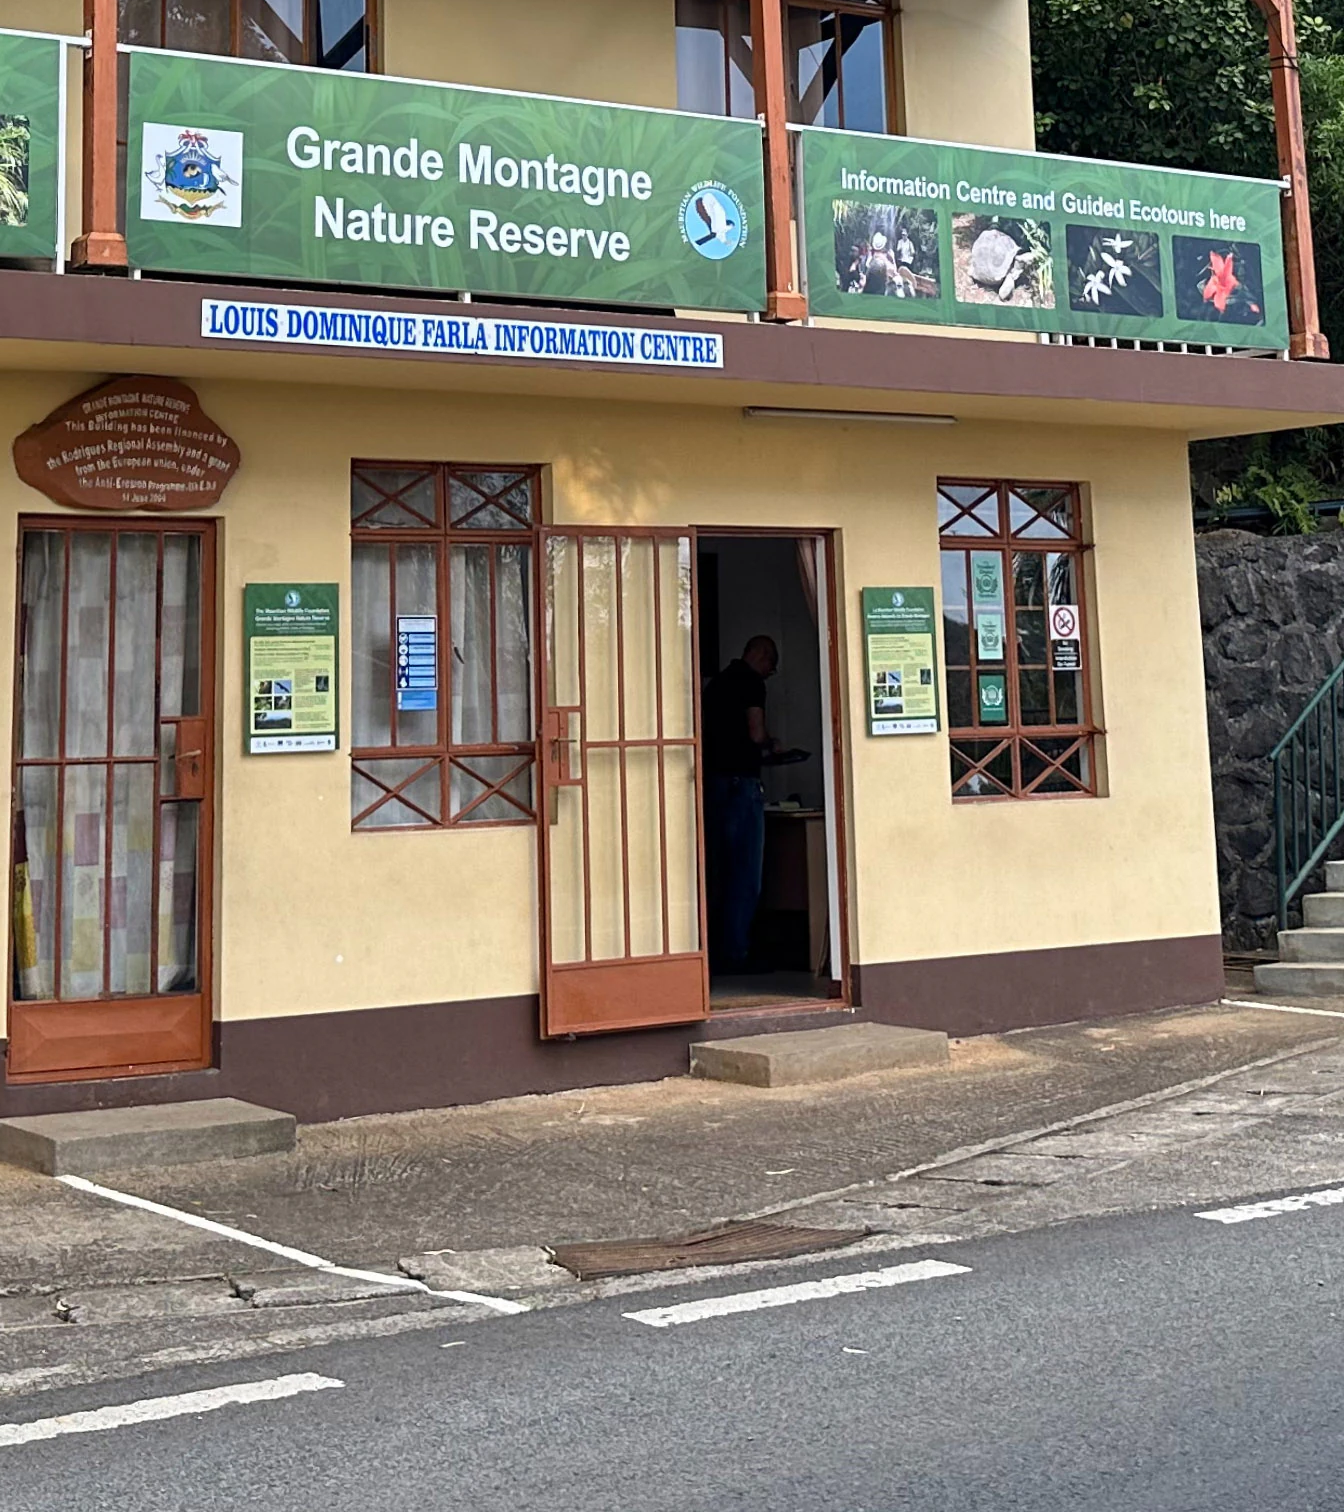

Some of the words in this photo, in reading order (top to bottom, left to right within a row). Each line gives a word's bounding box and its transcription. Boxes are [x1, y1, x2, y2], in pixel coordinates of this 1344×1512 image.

[286, 125, 444, 181] Grande
[459, 143, 653, 206] Montagne
[841, 167, 950, 200] Information
[956, 180, 1017, 208] Centre
[1022, 190, 1056, 212] and
[1061, 192, 1124, 219] Guided
[1130, 202, 1205, 228] Ecotours
[1209, 208, 1246, 232] here
[314, 196, 455, 249] Nature
[470, 209, 631, 262] Reserve
[210, 304, 279, 338] LOUIS
[287, 310, 416, 347] DOMINIQUE
[420, 319, 489, 351] FARLA
[494, 324, 635, 359] INFORMATION
[640, 331, 717, 364] CENTRE
[65, 420, 85, 431] This
[131, 422, 147, 432] has
[150, 423, 172, 435] been
[217, 434, 228, 447] by
[149, 410, 179, 424] CENTRE
[46, 456, 62, 470] the
[61, 444, 106, 464] Rodrigues
[107, 437, 144, 454] Regional
[146, 437, 186, 458] Assembly
[185, 448, 203, 460] and
[208, 455, 231, 472] grant
[75, 463, 96, 476] from
[96, 459, 111, 471] the
[111, 456, 152, 469] European
